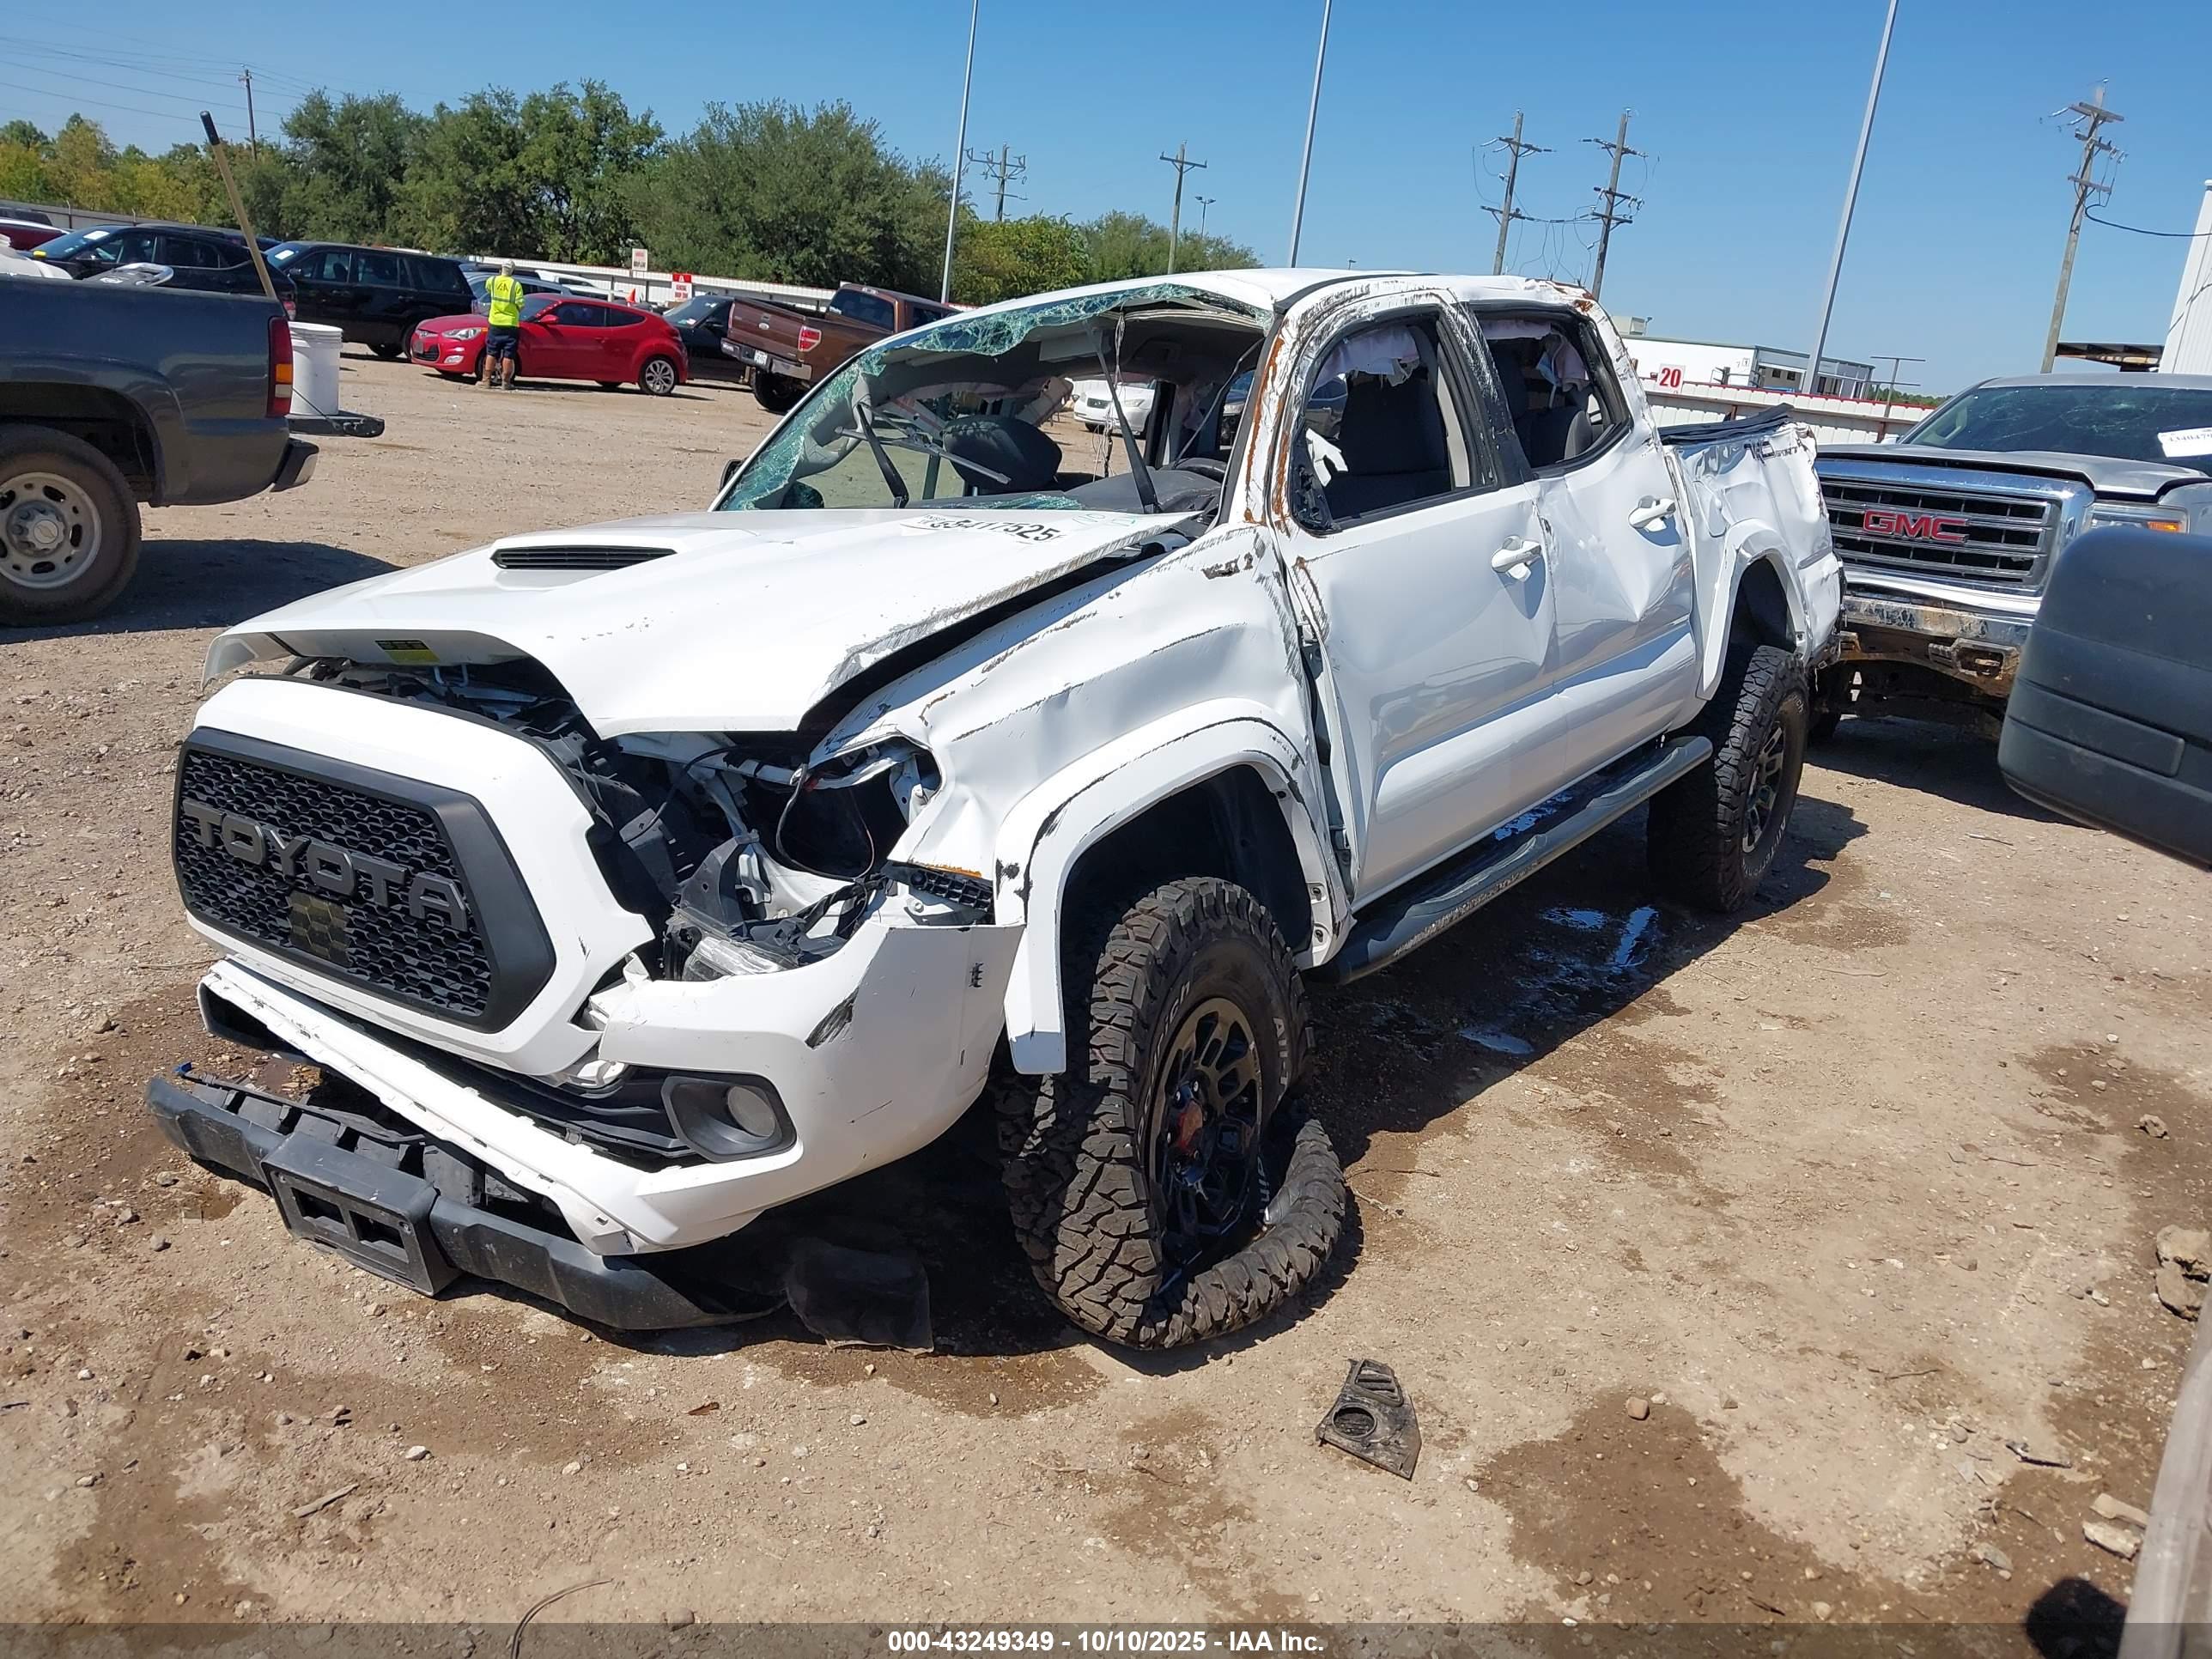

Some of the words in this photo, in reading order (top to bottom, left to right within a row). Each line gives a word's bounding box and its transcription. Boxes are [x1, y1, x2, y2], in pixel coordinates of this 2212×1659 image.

[1659, 367, 1682, 388] 20
[1863, 508, 1969, 544] GMC
[183, 799, 468, 932] TOYOTA
